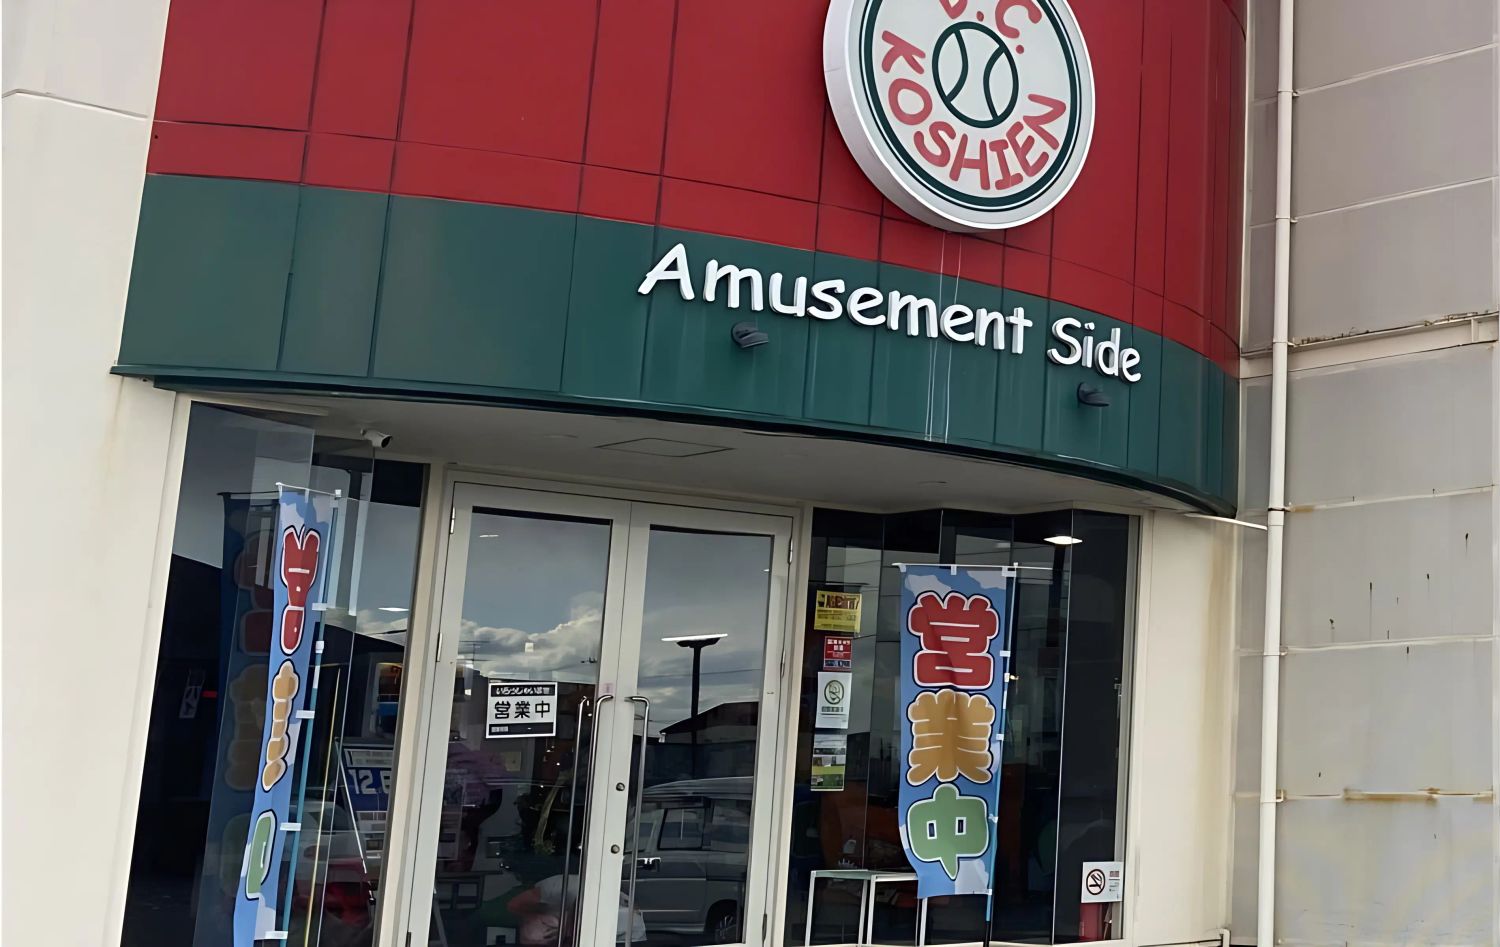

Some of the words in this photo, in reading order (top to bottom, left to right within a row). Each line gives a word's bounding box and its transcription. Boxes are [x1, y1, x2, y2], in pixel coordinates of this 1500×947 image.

[881, 30, 1067, 190] KOSHIEN
[637, 243, 1034, 355] Amusement
[1046, 317, 1143, 383] Side
[494, 700, 551, 719] 営業中
[906, 589, 1000, 881] 営業中
